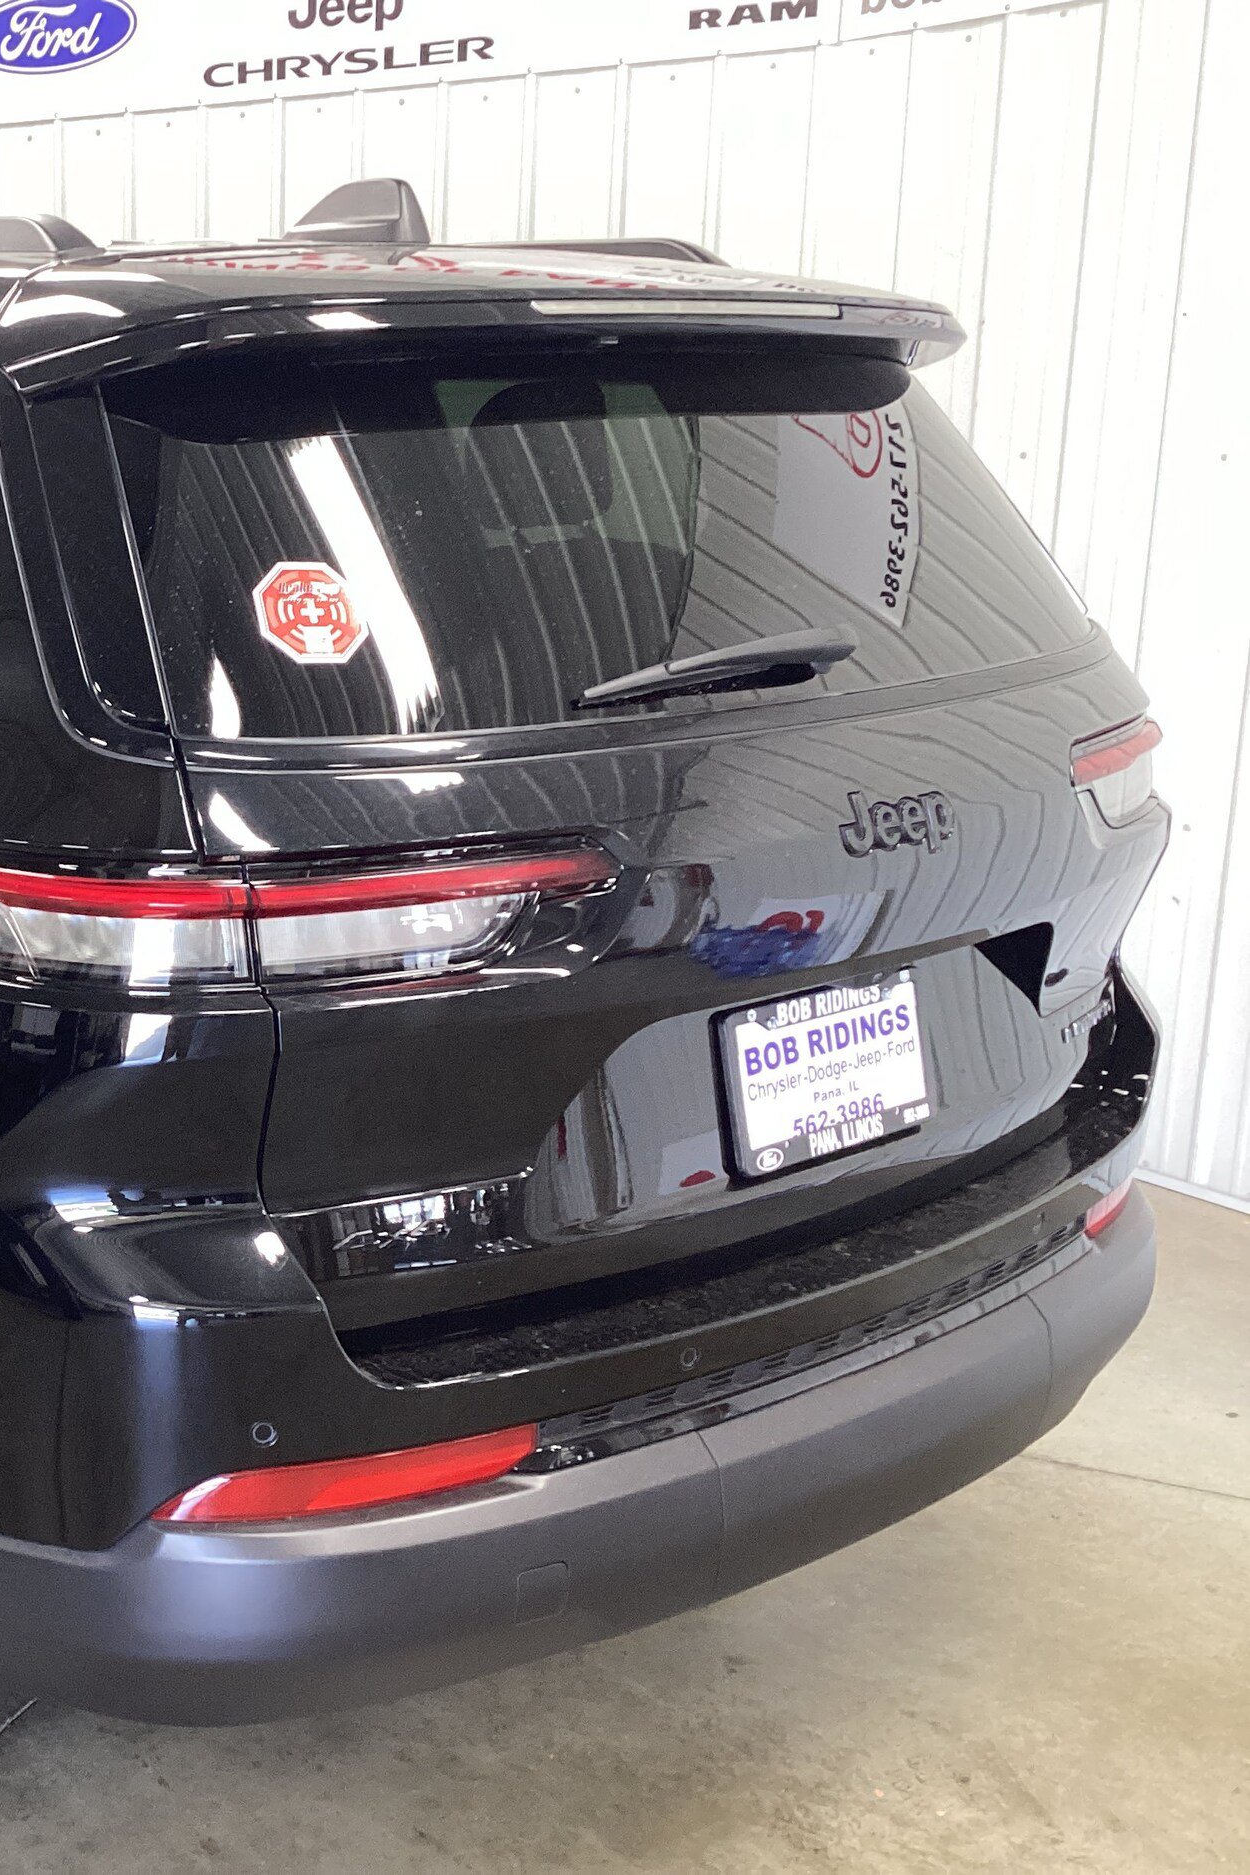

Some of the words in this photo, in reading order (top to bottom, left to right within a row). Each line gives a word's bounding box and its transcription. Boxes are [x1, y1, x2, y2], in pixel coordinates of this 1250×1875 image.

[0, 4, 103, 61] Ford
[288, 0, 403, 31] Jeep
[688, 0, 818, 30] RAM
[203, 36, 495, 87] CHRYSLER
[839, 790, 955, 858] Jeep
[776, 998, 812, 1026] BOB
[815, 984, 880, 1016] RIDINGS
[744, 1036, 799, 1076] BOB
[807, 1004, 910, 1057] RIDINGS
[849, 1080, 860, 1092] IL
[793, 1093, 885, 1137] 562-3986
[842, 1113, 884, 1148] ILLINOIS
